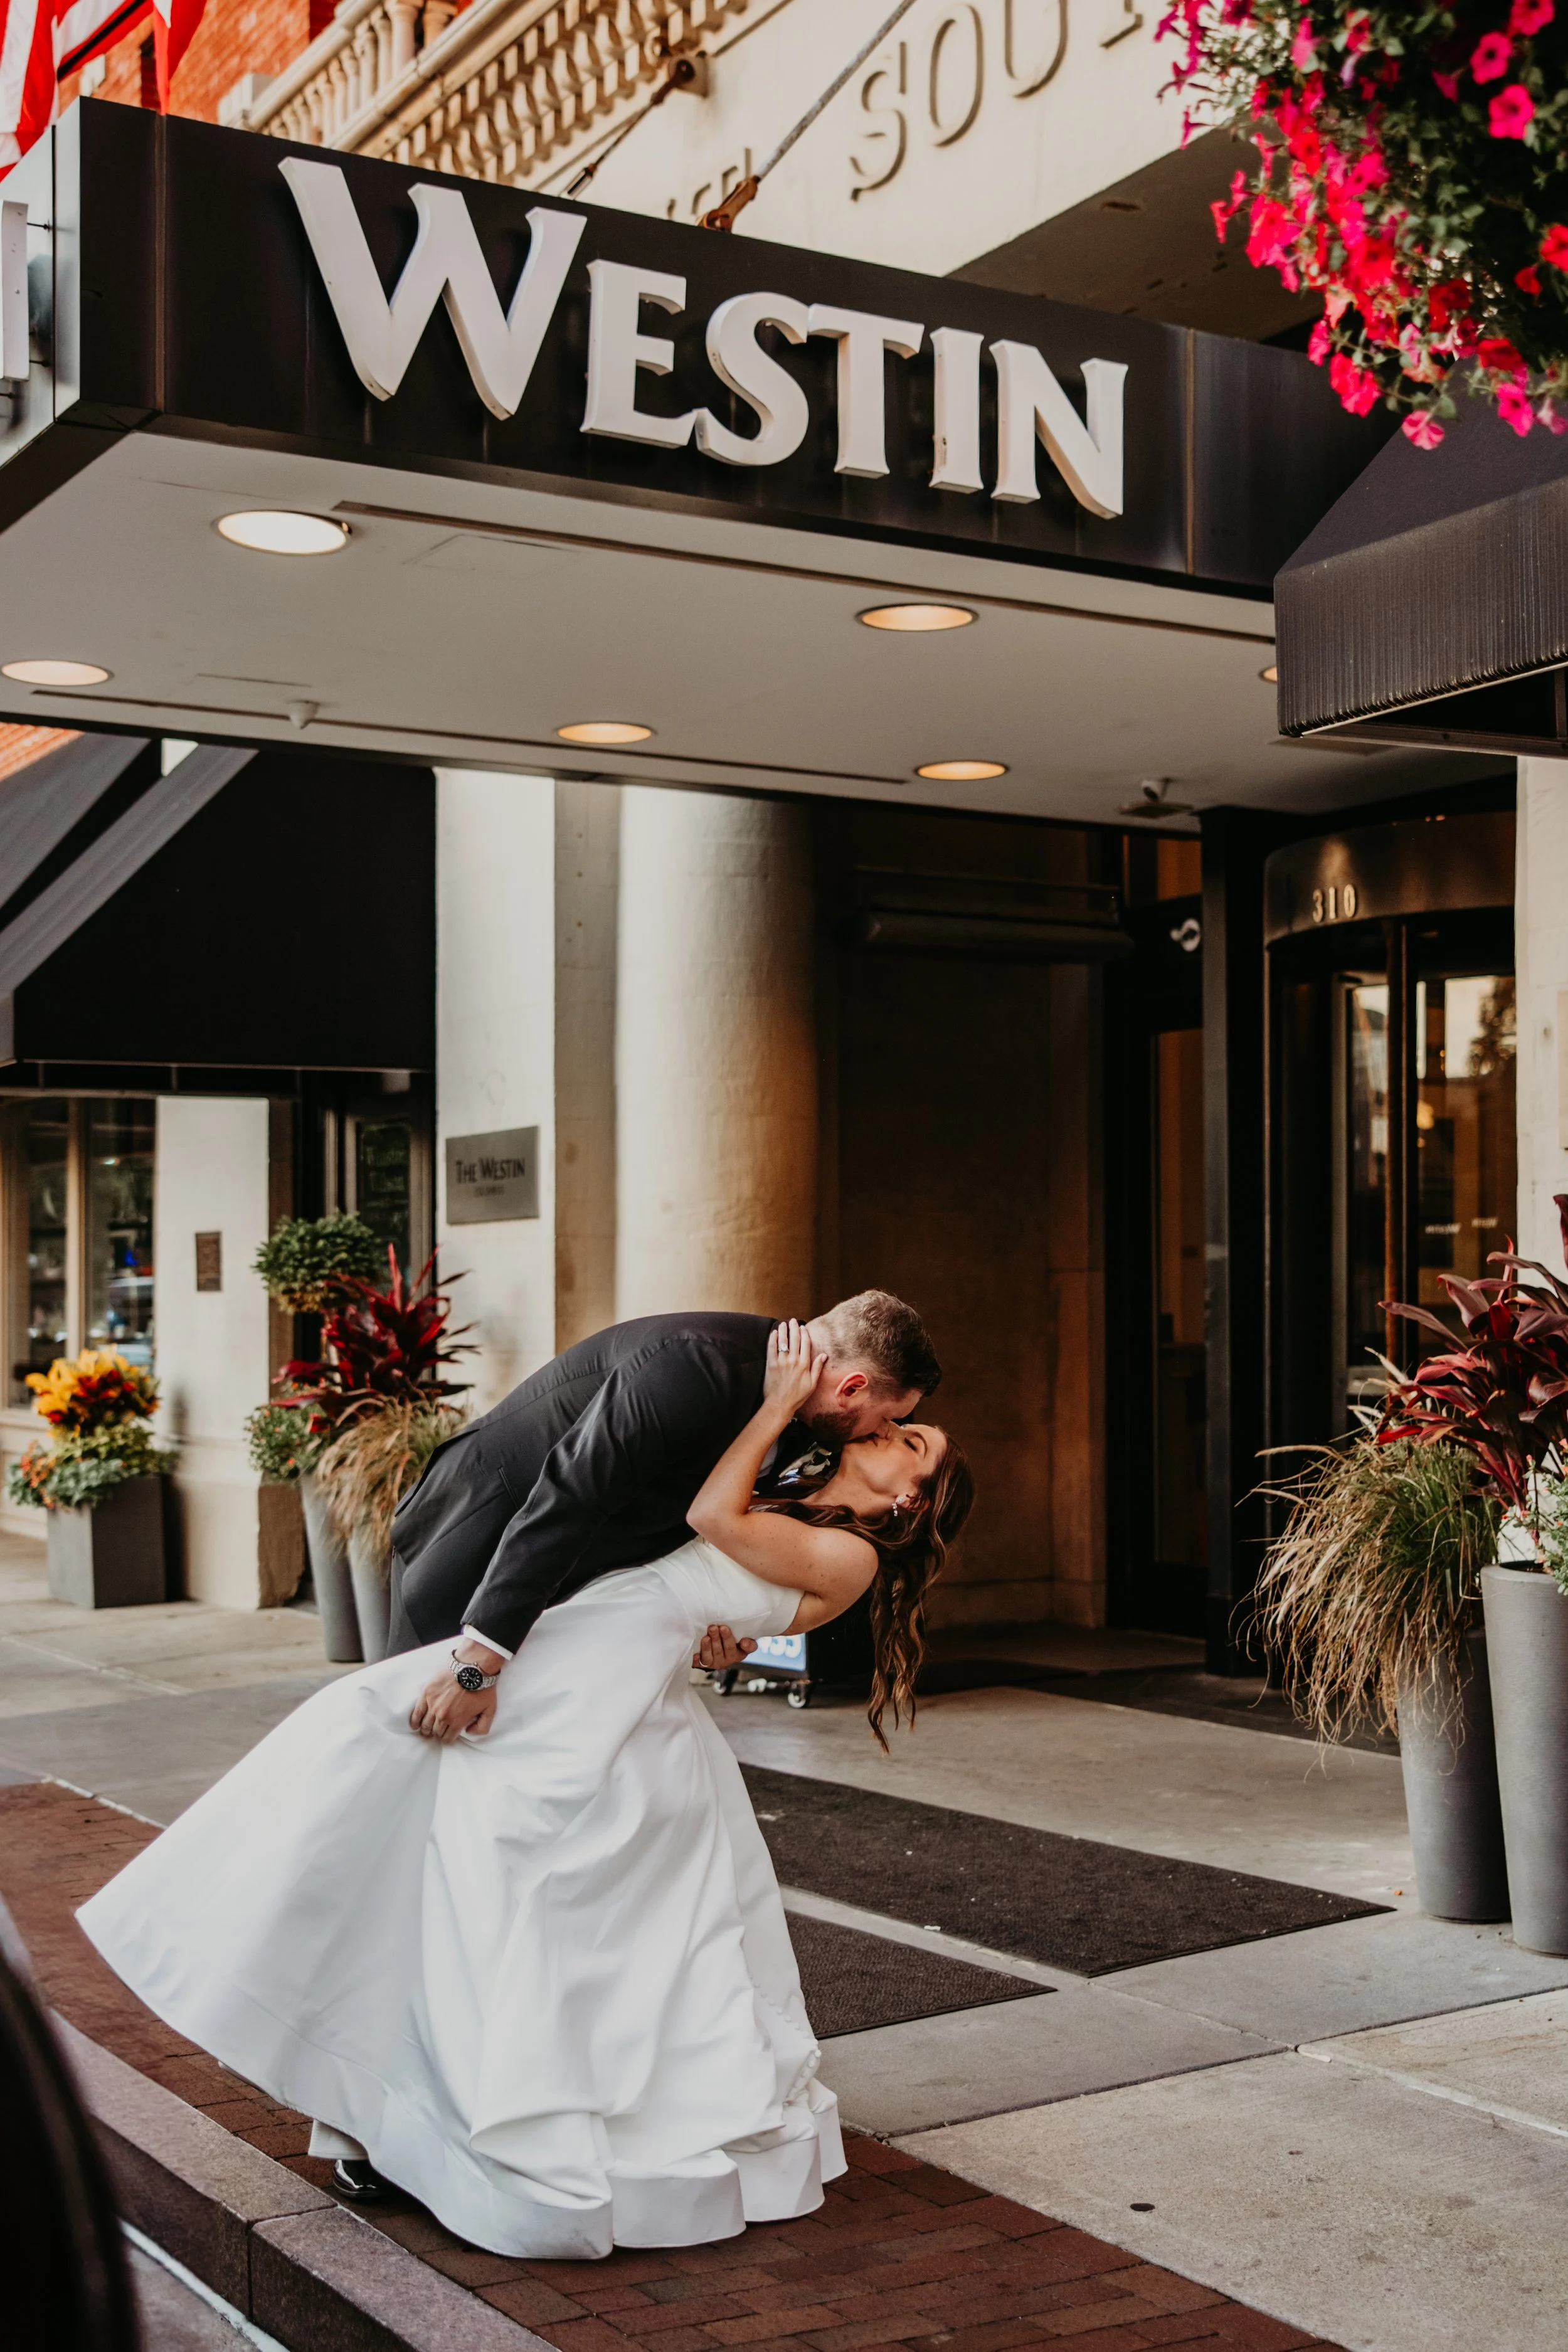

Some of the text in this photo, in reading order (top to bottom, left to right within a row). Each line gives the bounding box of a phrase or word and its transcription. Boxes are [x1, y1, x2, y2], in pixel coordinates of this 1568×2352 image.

[278, 156, 1128, 519] WESTIN
[1312, 884, 1356, 923] 310
[455, 1156, 526, 1184] THE WESTIN
